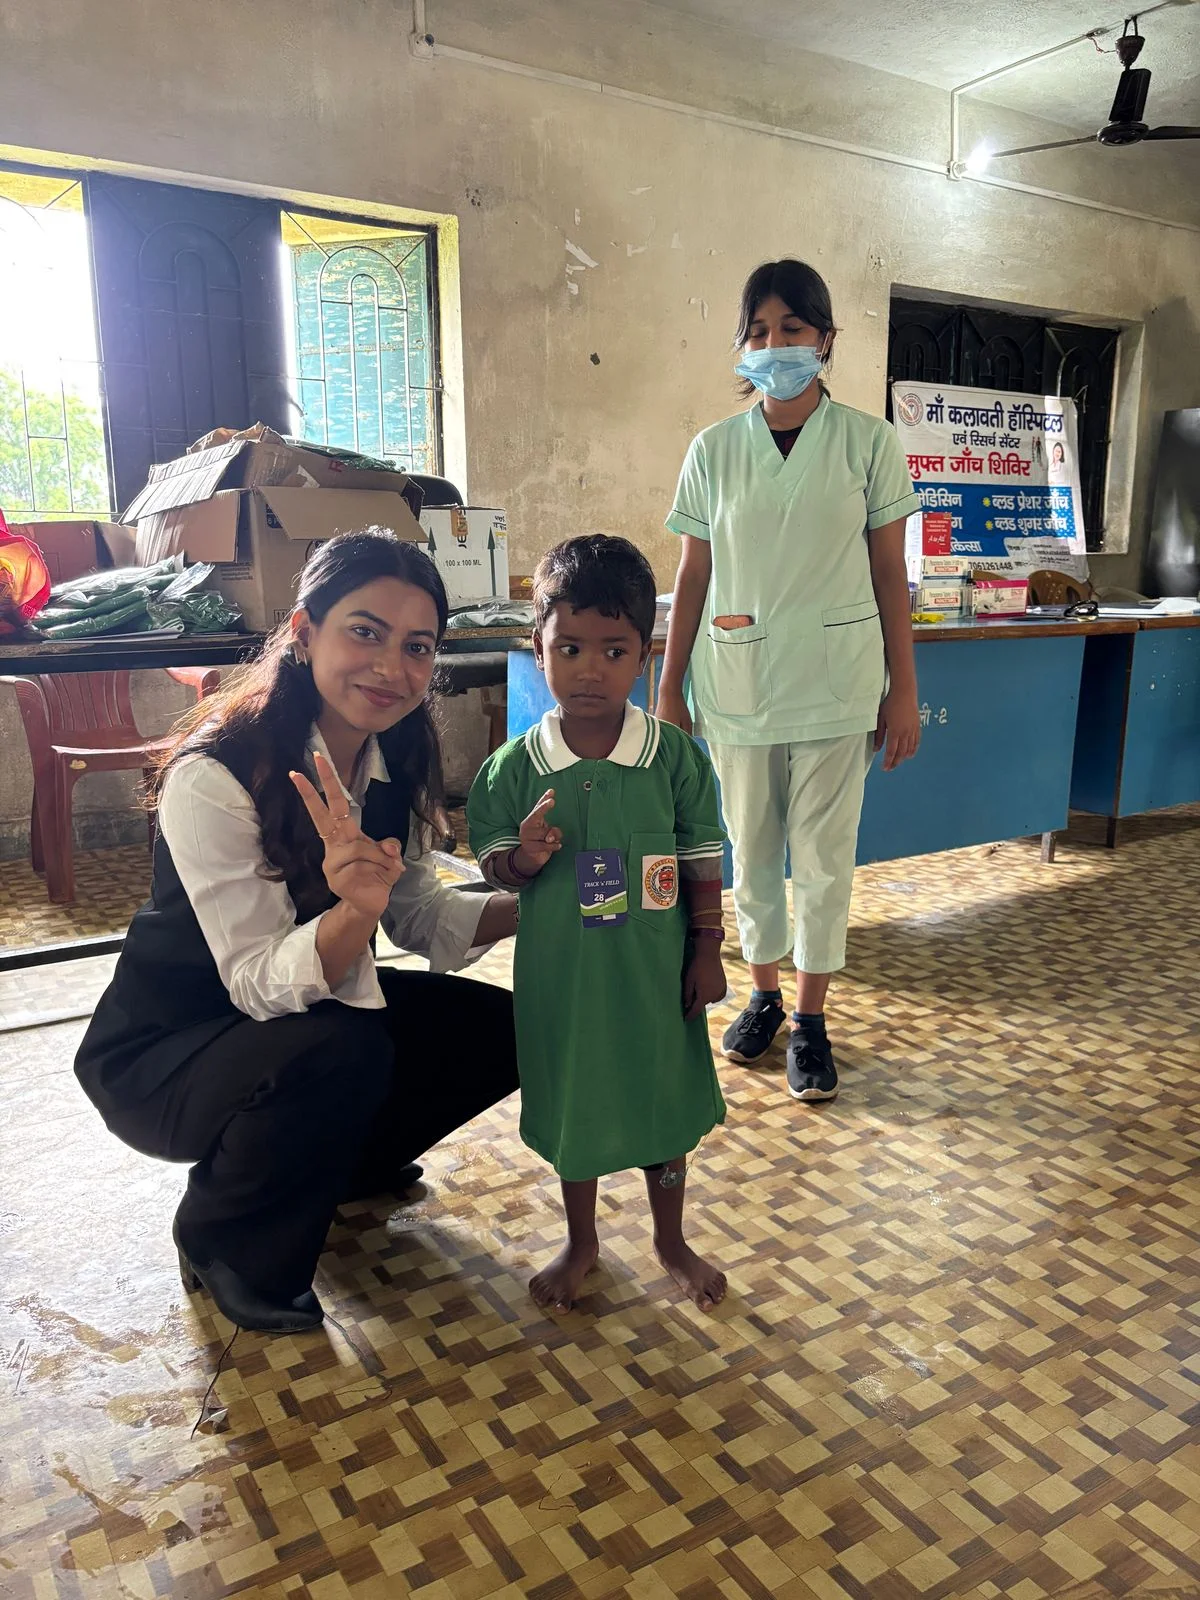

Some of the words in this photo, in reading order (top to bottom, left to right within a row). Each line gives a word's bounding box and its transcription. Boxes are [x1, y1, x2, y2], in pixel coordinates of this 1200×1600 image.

[926, 393, 944, 423] माँ
[948, 401, 1004, 428] कलावती
[1007, 403, 1063, 433] हॉस्पिटल
[952, 430, 967, 445] एवं
[970, 430, 996, 447] रिसर्च
[998, 433, 1021, 449] सेंटर
[906, 454, 945, 480] मुफ्त
[948, 447, 984, 474] जाँच
[987, 451, 1031, 476] शिविर
[992, 494, 1015, 511] ब्लड
[1017, 490, 1042, 512] प्रेशर
[1042, 487, 1069, 510] जाँच
[594, 893, 604, 901] 28
